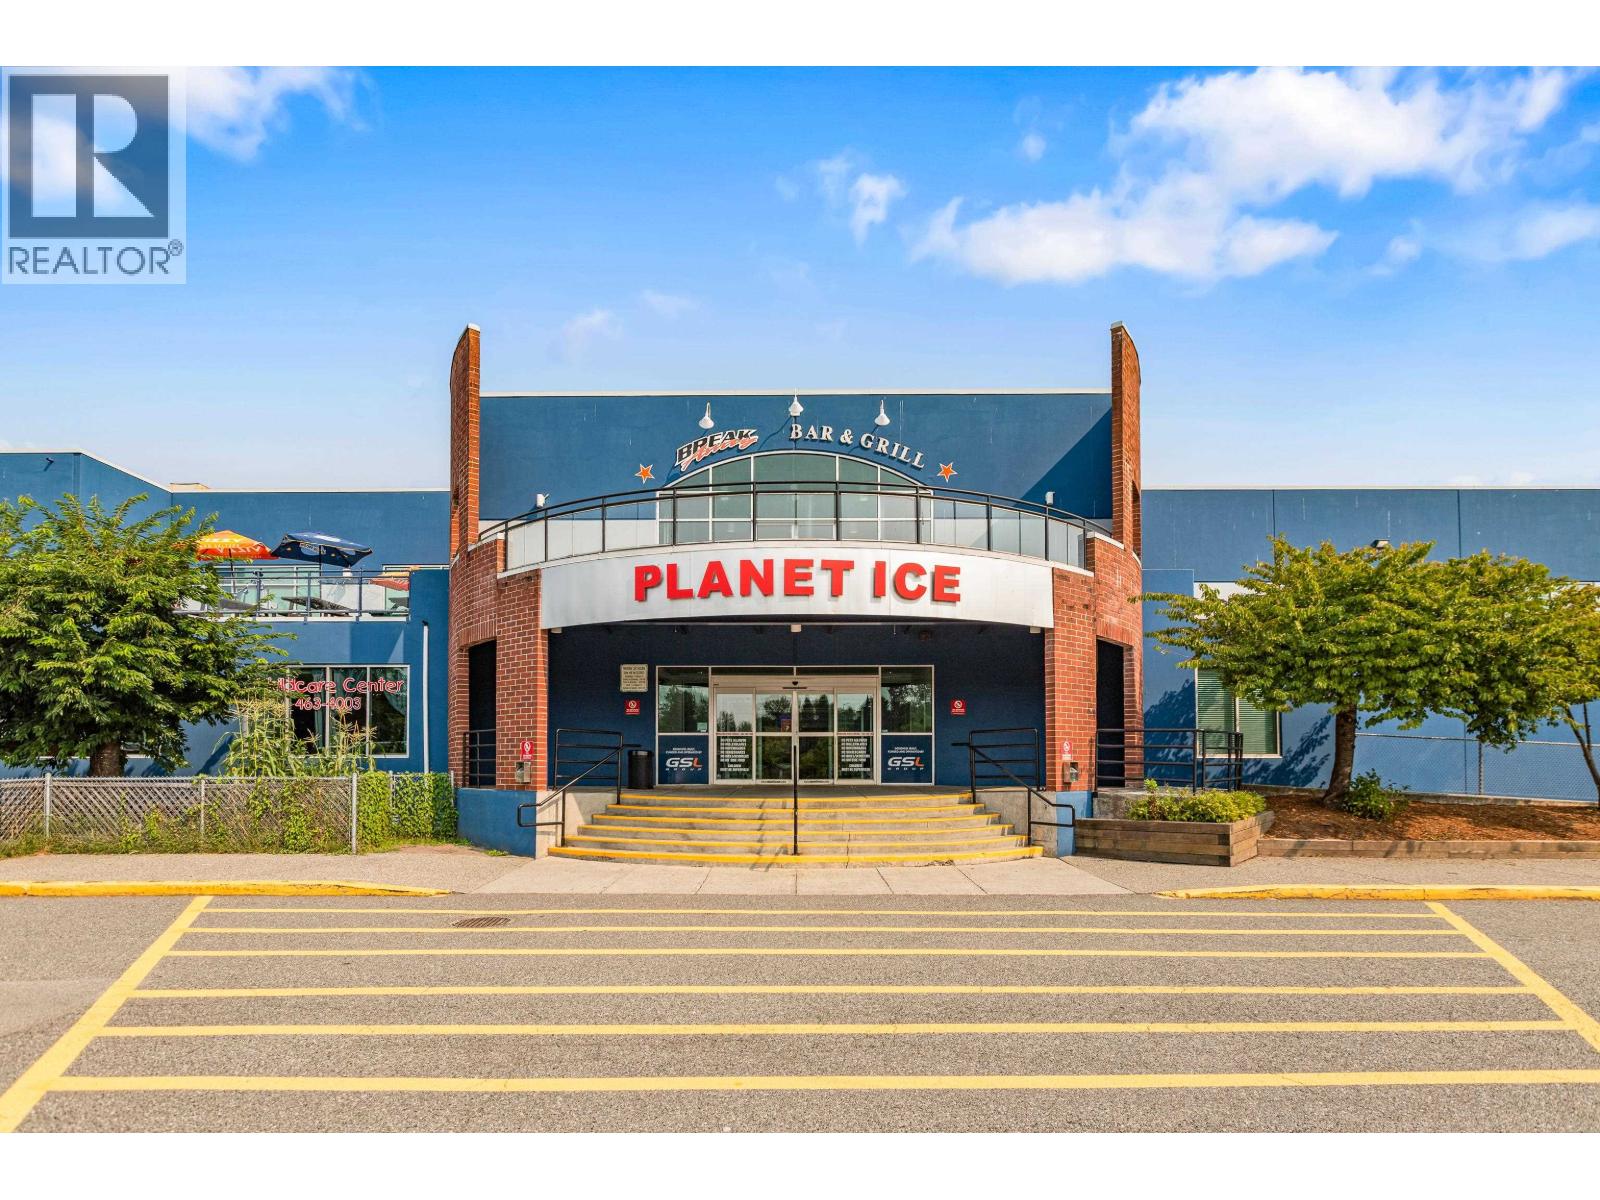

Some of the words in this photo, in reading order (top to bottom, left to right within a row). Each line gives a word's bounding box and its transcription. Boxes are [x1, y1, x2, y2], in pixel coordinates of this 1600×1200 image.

[675, 429, 756, 465] BREAK
[790, 424, 833, 441] BAR
[840, 428, 854, 445] &
[860, 433, 925, 468] GRILL
[633, 559, 855, 602] PLANET
[873, 560, 962, 603] ICE
[342, 677, 405, 694] Center
[665, 757, 703, 768] GSL
[887, 756, 925, 767] GSL
